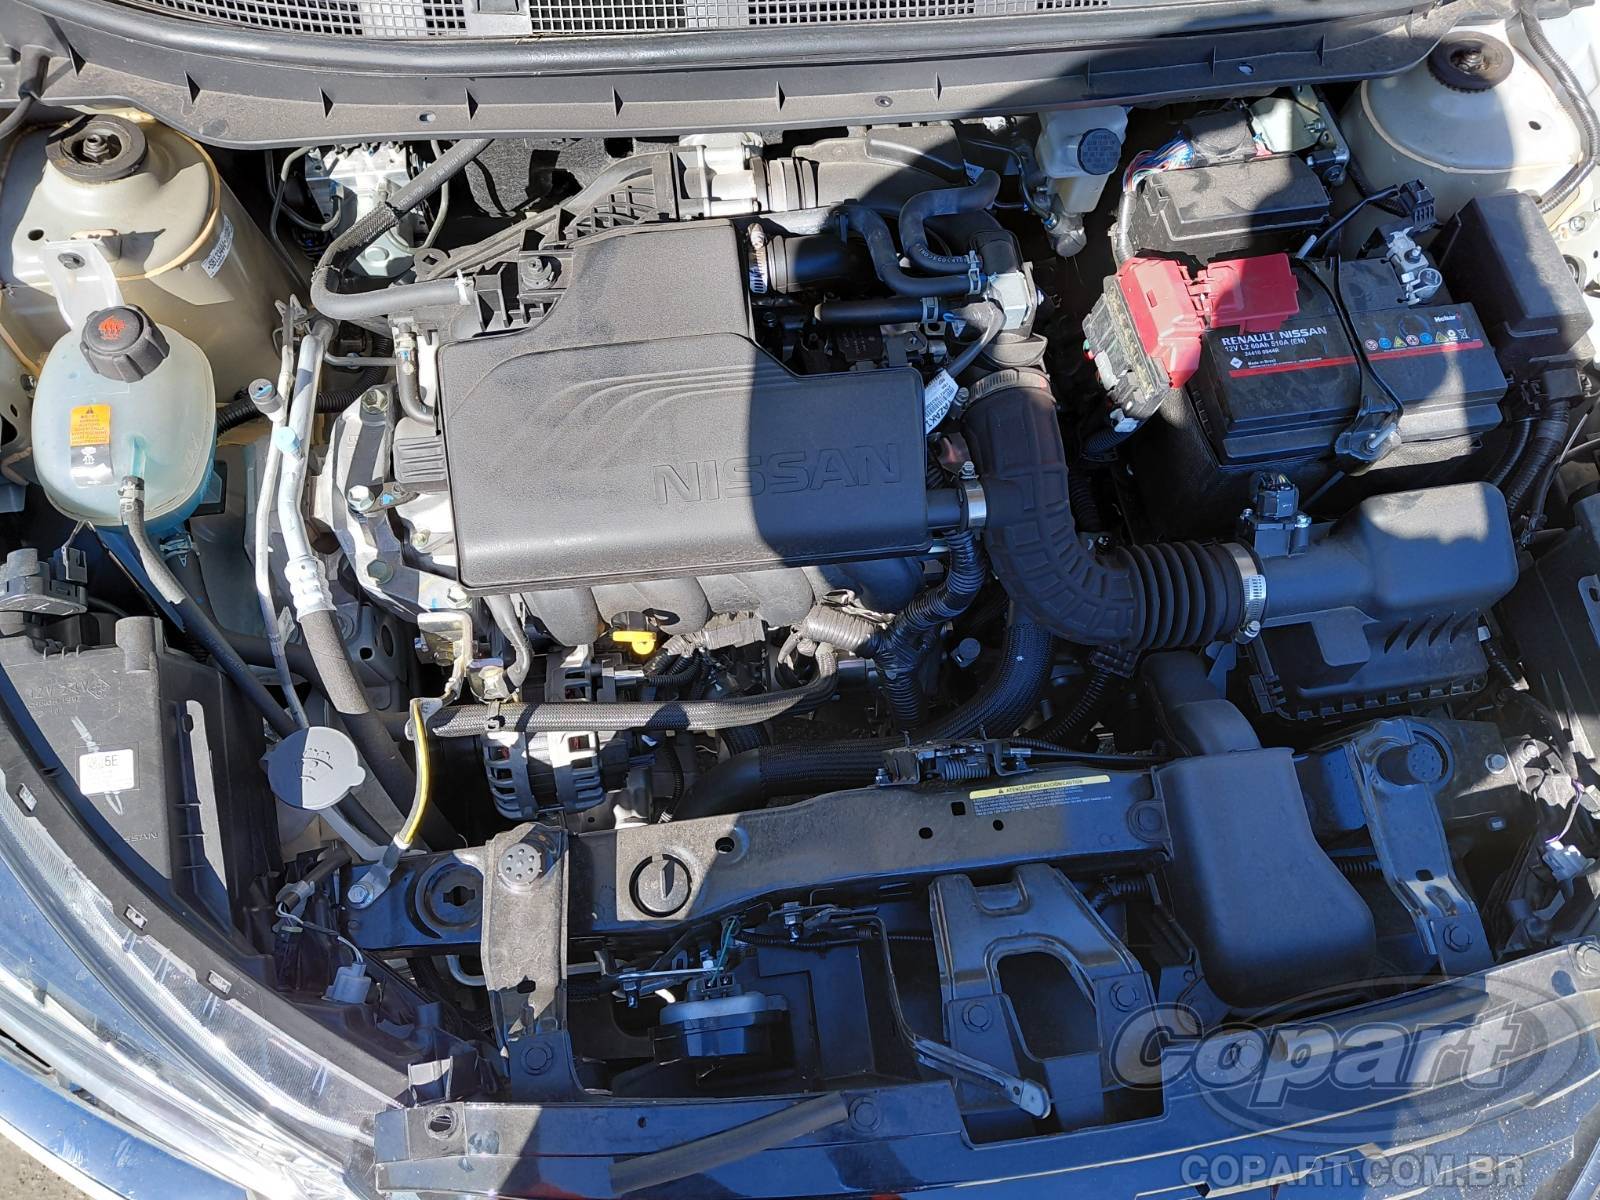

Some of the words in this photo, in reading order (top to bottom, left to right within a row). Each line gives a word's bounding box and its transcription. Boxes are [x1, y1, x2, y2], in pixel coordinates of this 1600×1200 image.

[1221, 332, 1274, 345] RENAULT
[1279, 326, 1327, 338] NISSAN
[652, 443, 902, 505] NISSAN
